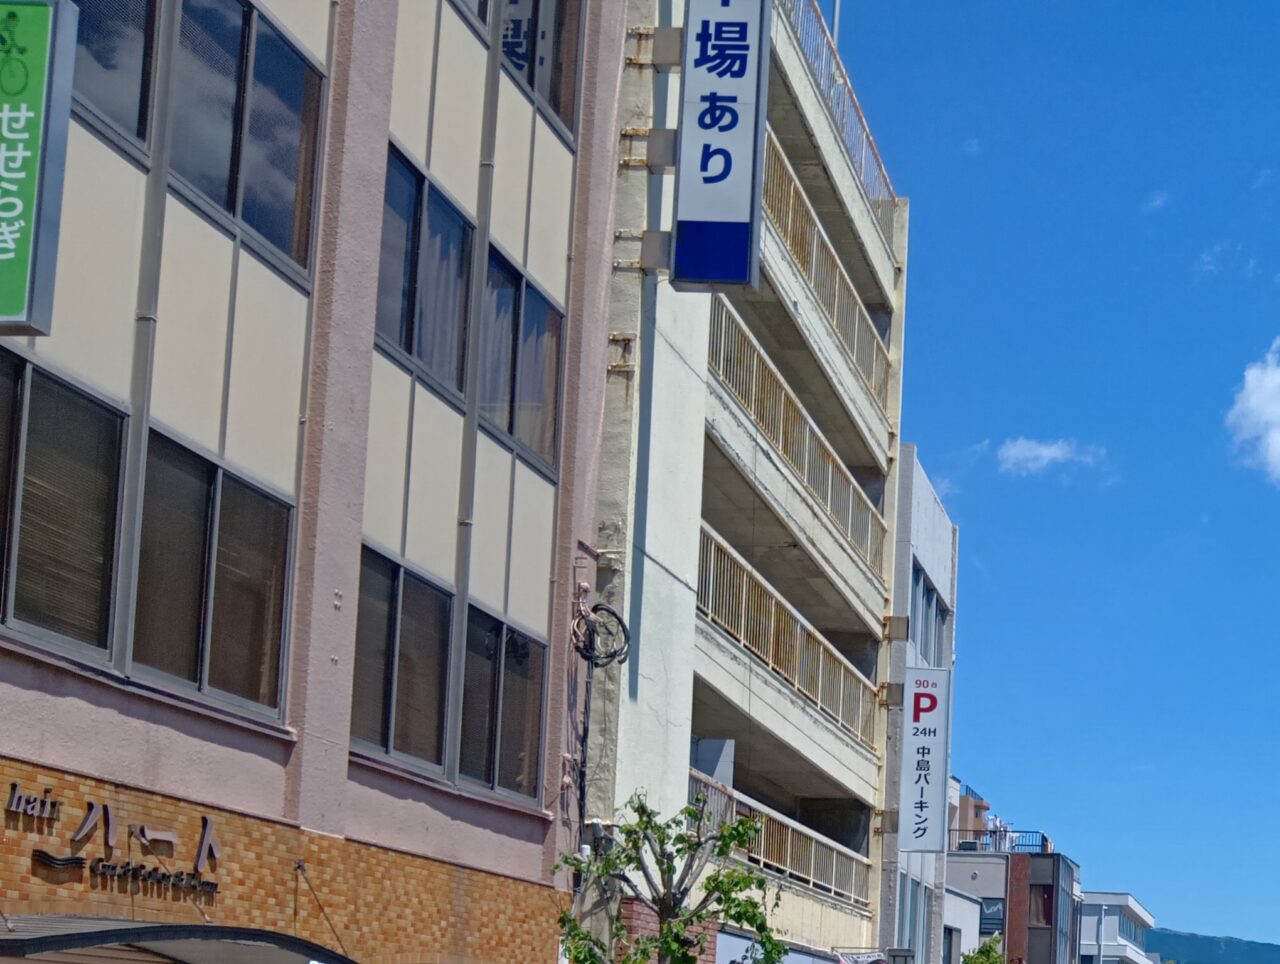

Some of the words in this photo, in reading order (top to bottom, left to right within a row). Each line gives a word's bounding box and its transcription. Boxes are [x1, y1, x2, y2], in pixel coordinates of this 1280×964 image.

[692, 0, 750, 185] 場あり
[912, 692, 938, 723] P
[912, 727, 937, 737] 24H
[7, 782, 60, 822] hair
[912, 745, 931, 839] 中島パーキング
[70, 801, 221, 873] ハート
